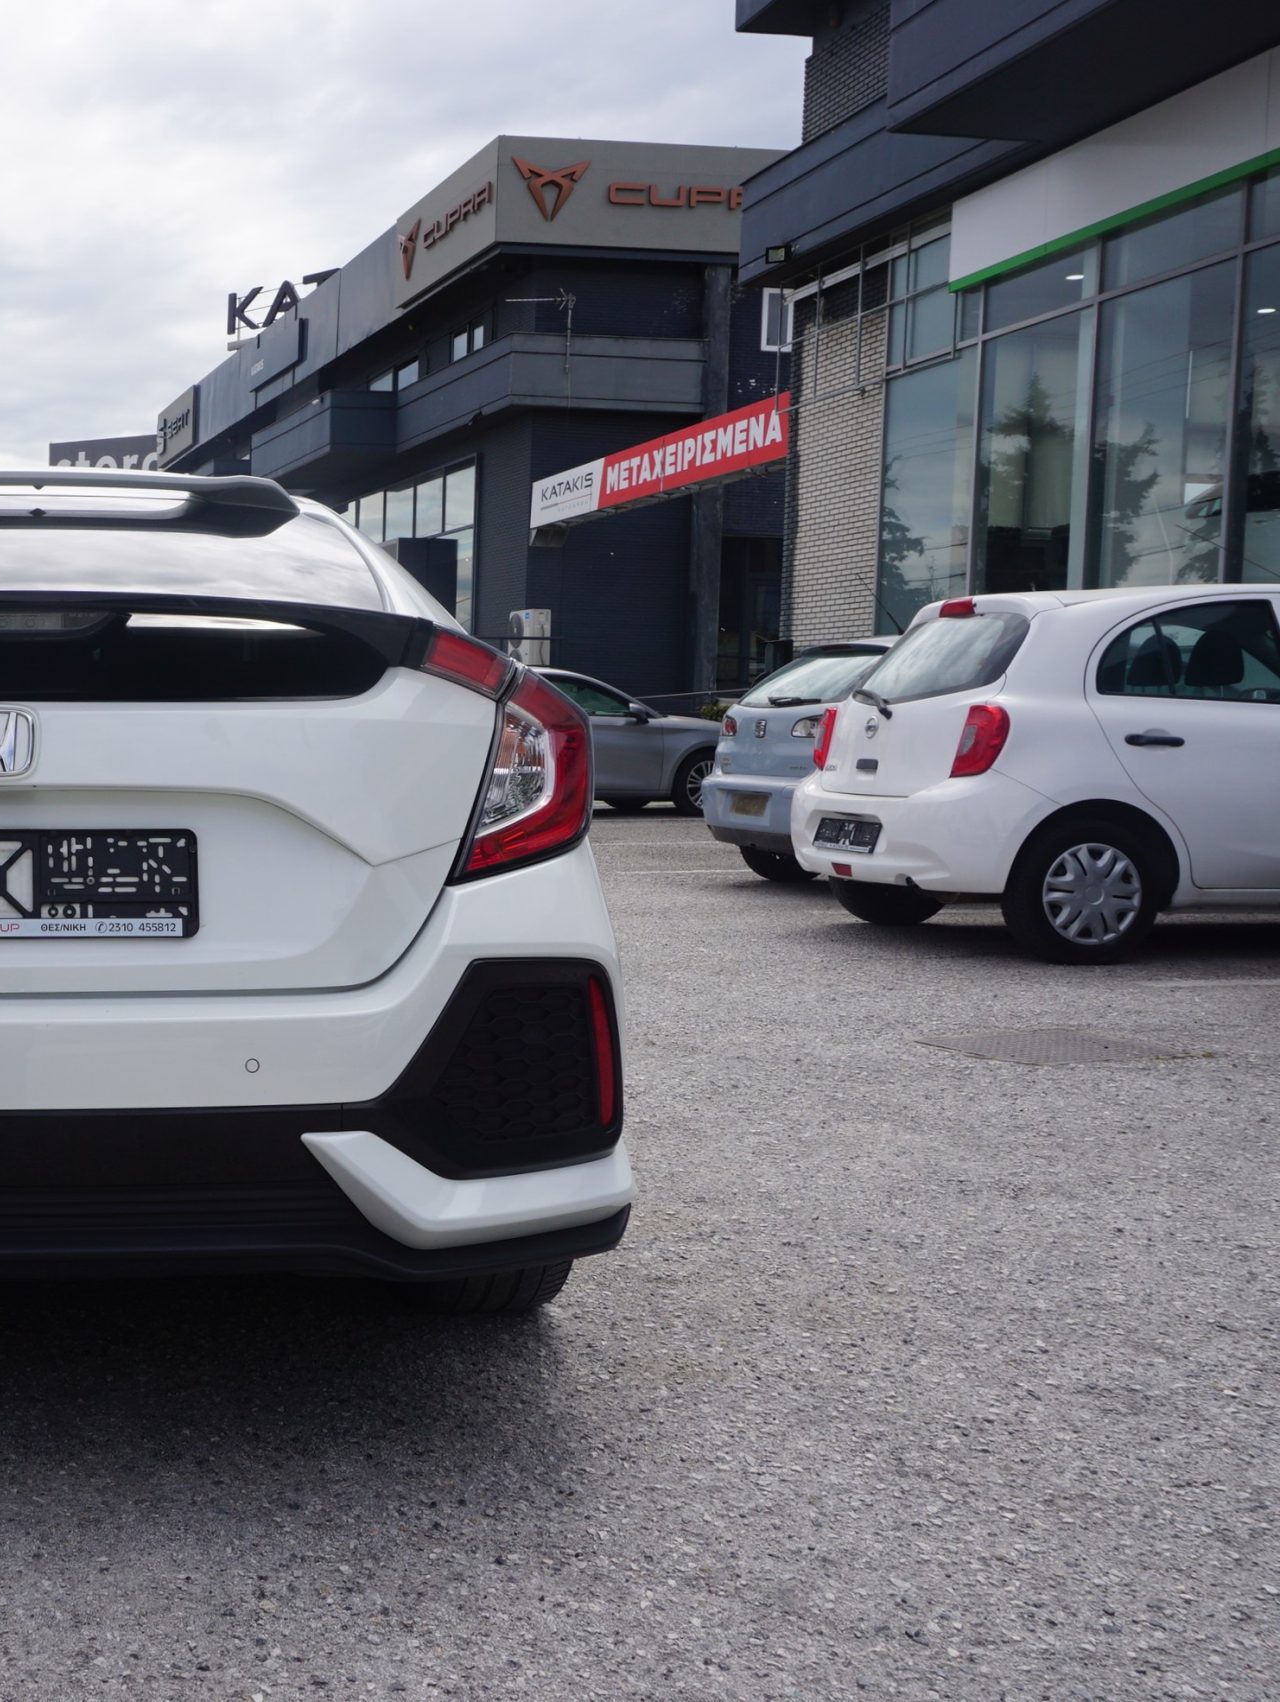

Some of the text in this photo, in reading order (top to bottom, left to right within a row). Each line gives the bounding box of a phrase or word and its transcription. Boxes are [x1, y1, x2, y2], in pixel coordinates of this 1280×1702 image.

[422, 181, 491, 249] CUPRA
[606, 410, 782, 494] ΜΕΤΑΧΕΙΡΙΣΜΕΝΑ
[541, 472, 593, 502] KATAKIS
[108, 922, 134, 932] 2310
[138, 922, 177, 932] 455812
